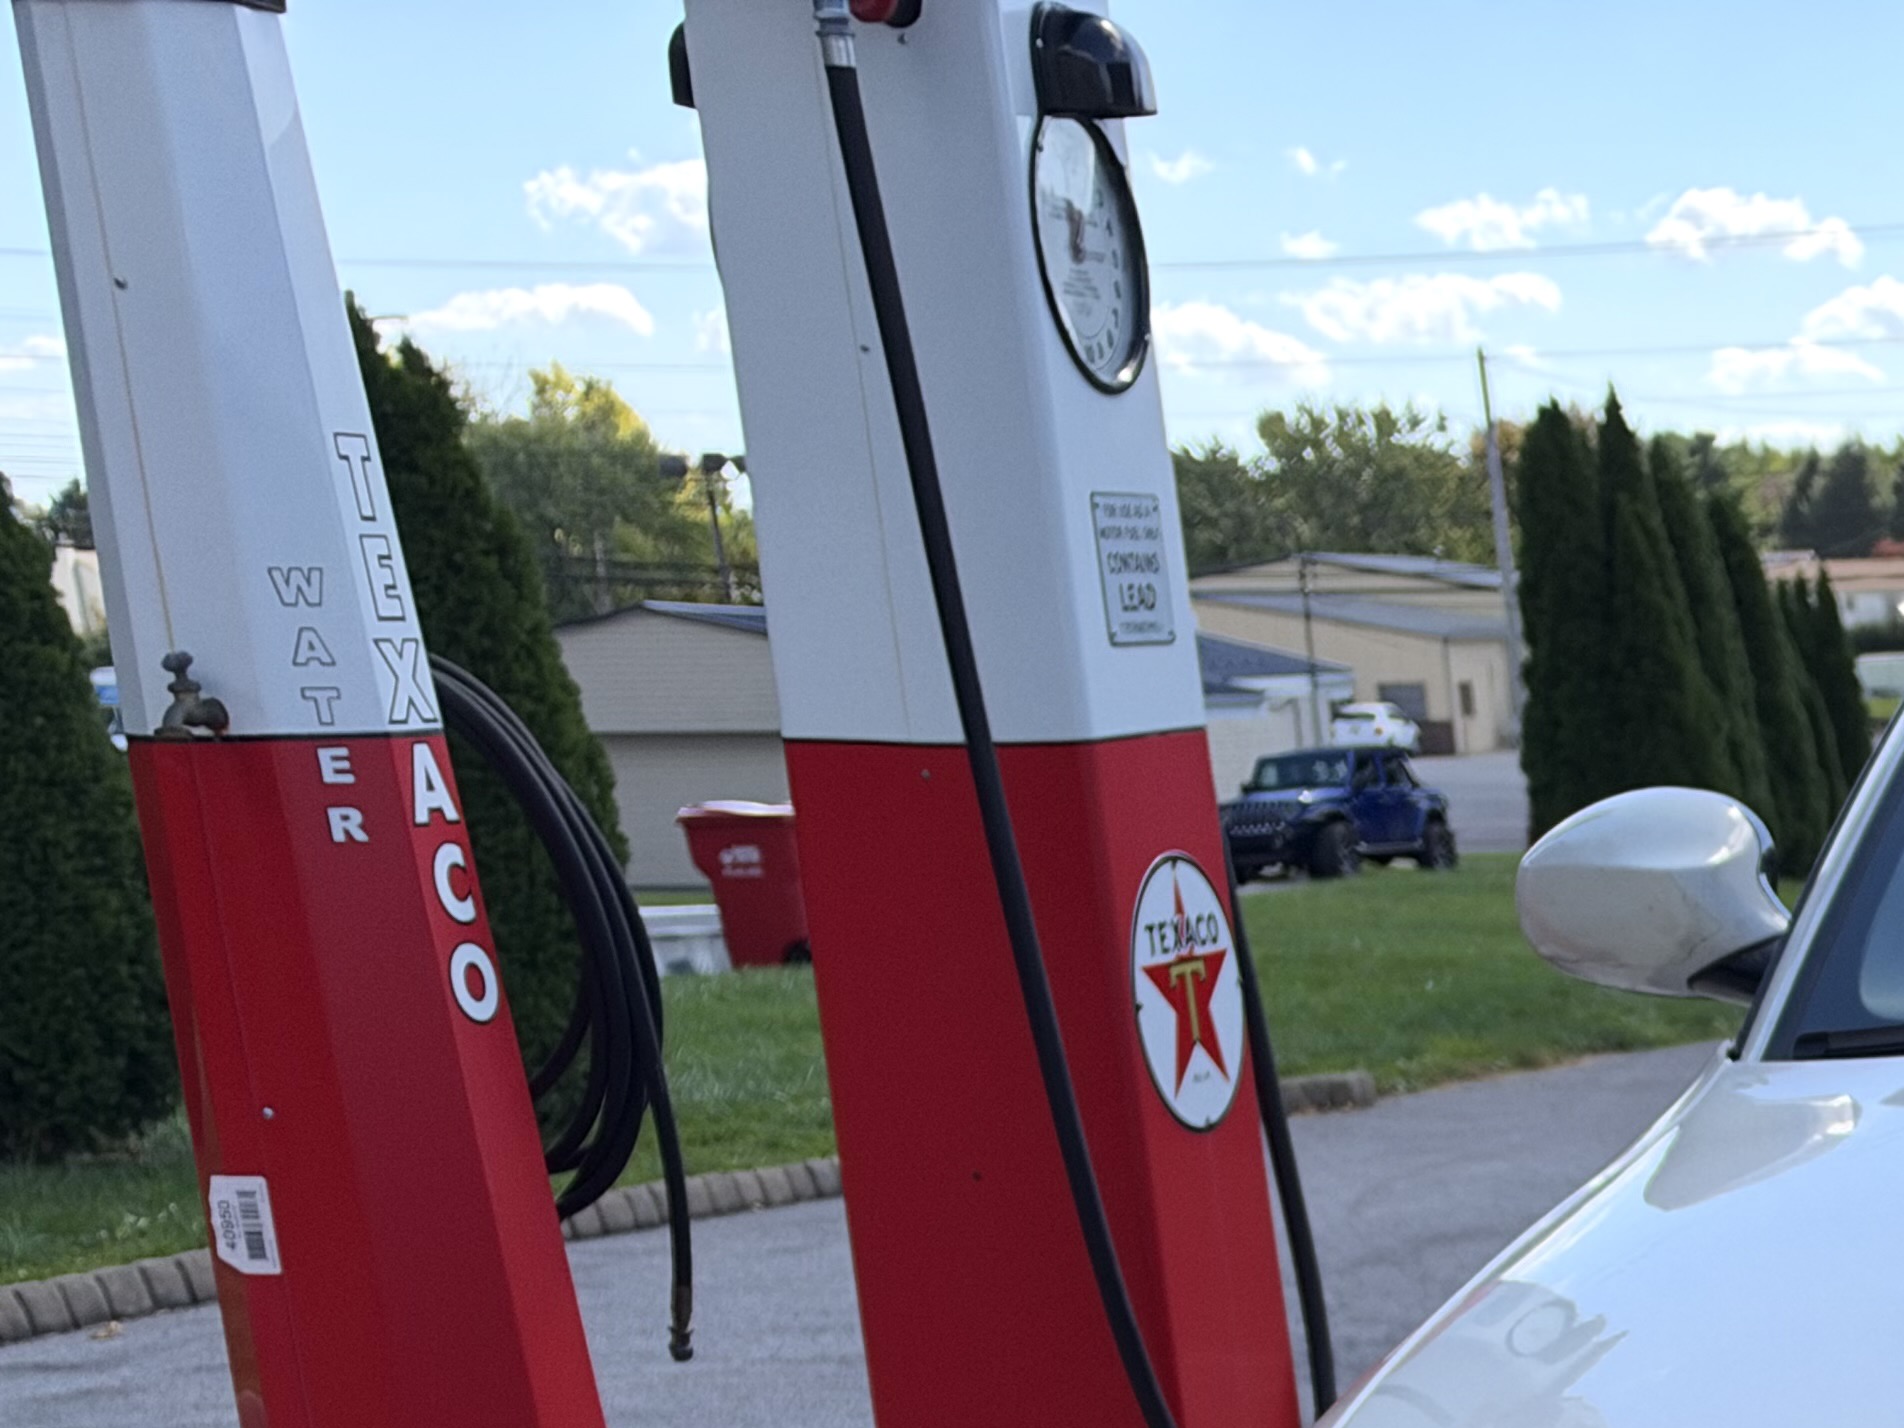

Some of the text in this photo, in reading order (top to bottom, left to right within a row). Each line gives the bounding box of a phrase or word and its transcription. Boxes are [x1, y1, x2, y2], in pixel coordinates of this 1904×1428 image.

[1107, 551, 1160, 574] CONTAINS
[1119, 582, 1157, 612] LEAD
[267, 566, 369, 843] WATER
[332, 432, 499, 1023] TEXACO
[1144, 911, 1219, 957] TEXACO
[1169, 956, 1207, 1044] T
